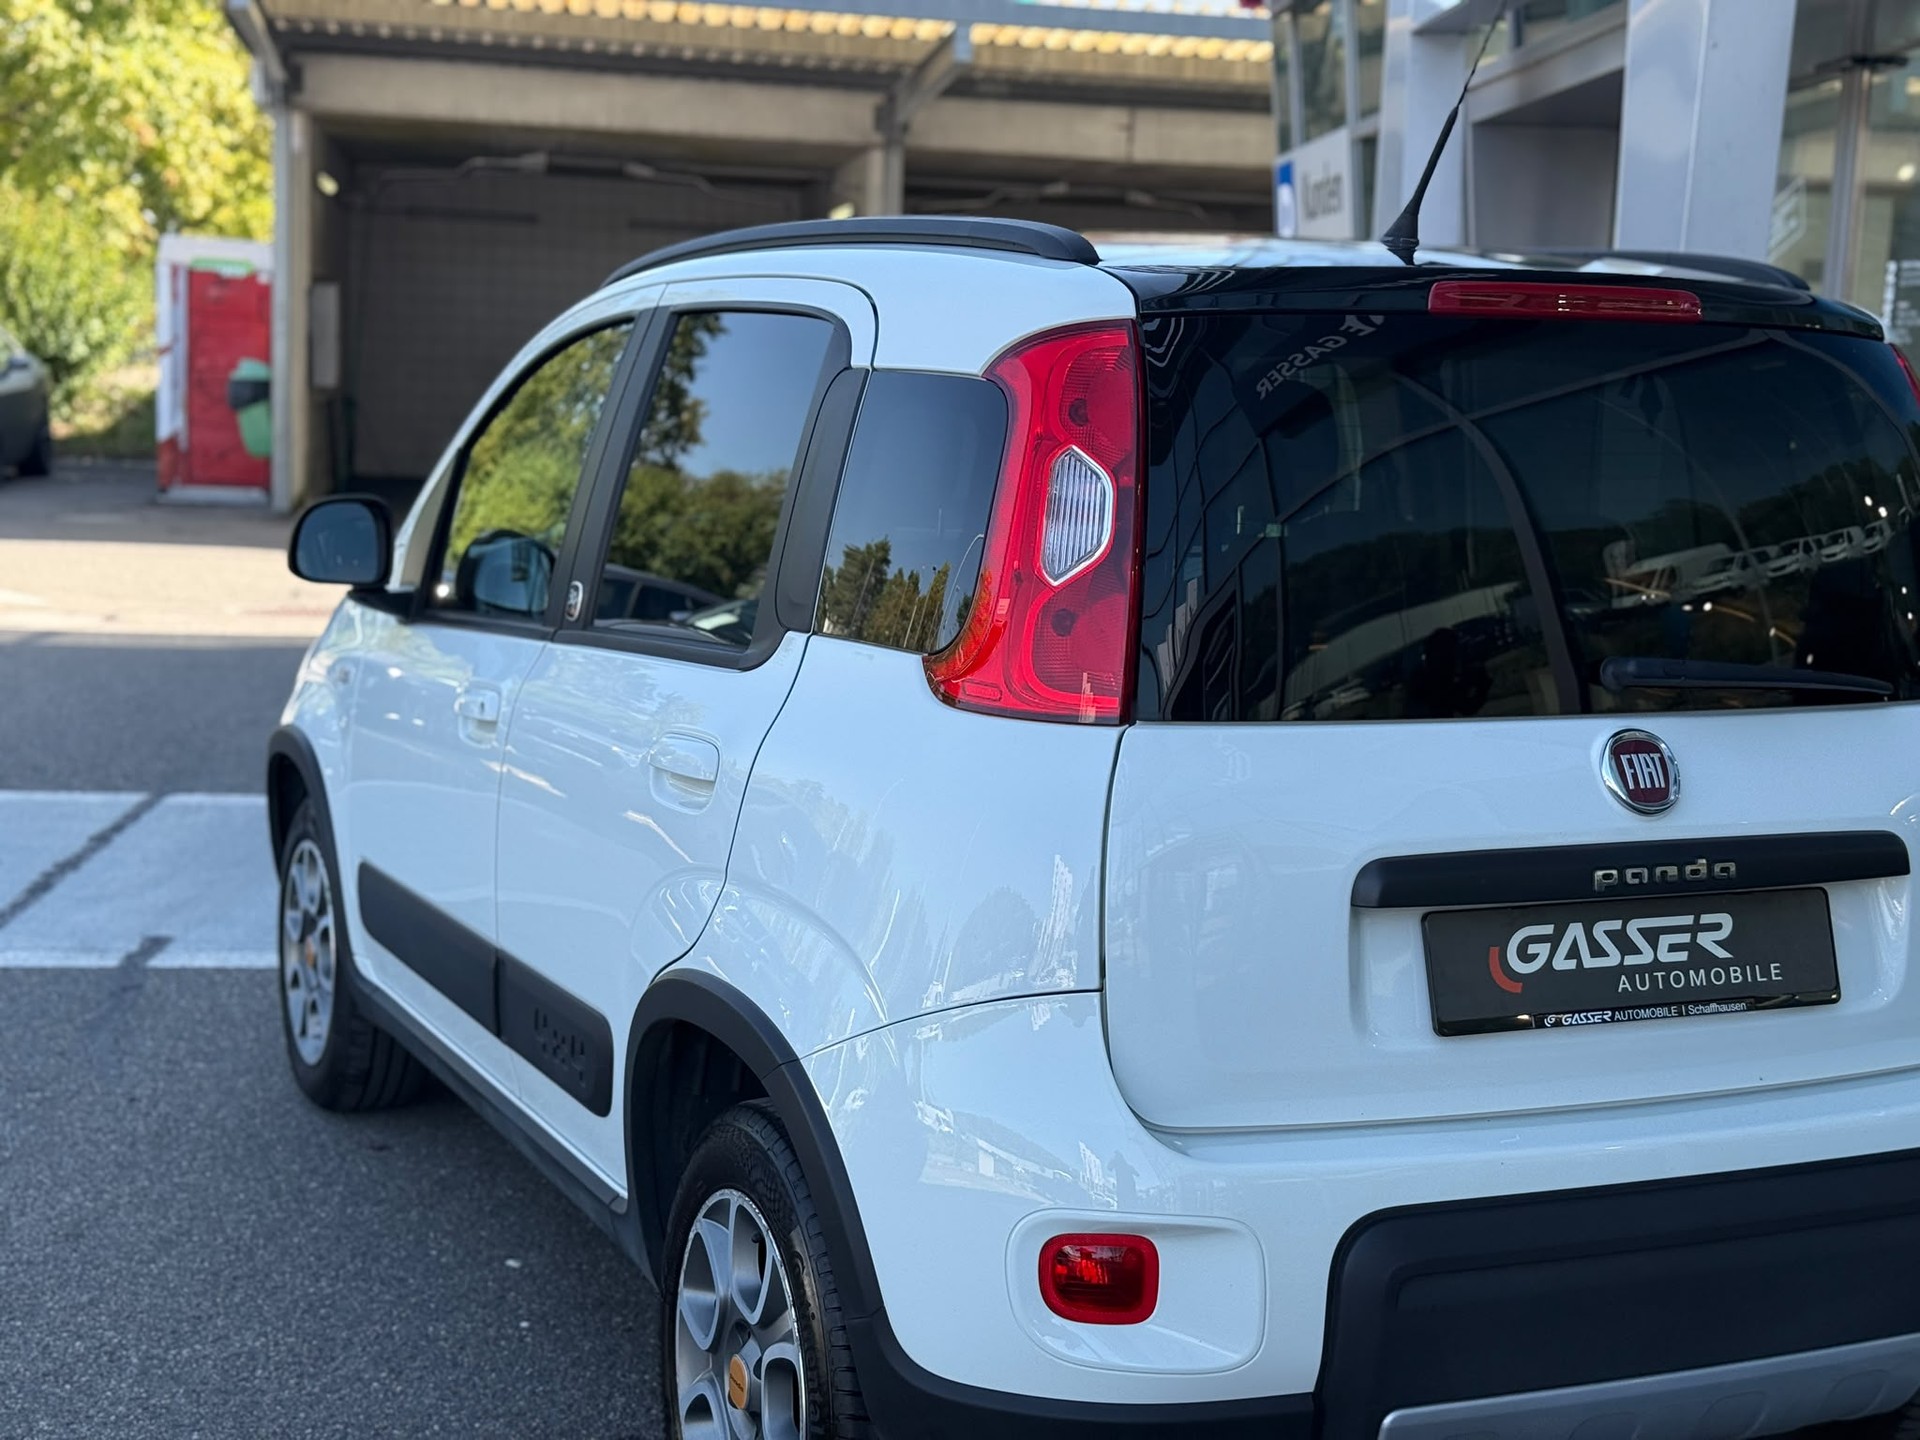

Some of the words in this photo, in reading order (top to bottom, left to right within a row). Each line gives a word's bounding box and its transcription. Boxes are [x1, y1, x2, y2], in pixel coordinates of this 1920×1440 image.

[1620, 752, 1666, 790] FIAT
[1594, 858, 1737, 892] panda
[1506, 912, 1735, 975] GASSER
[1617, 962, 1784, 993] AUTOMOBILE
[1561, 1010, 1613, 1026] GASSER
[1613, 1005, 1679, 1021] AUTOMOBILE
[1687, 1002, 1747, 1015] Schaffhausen
